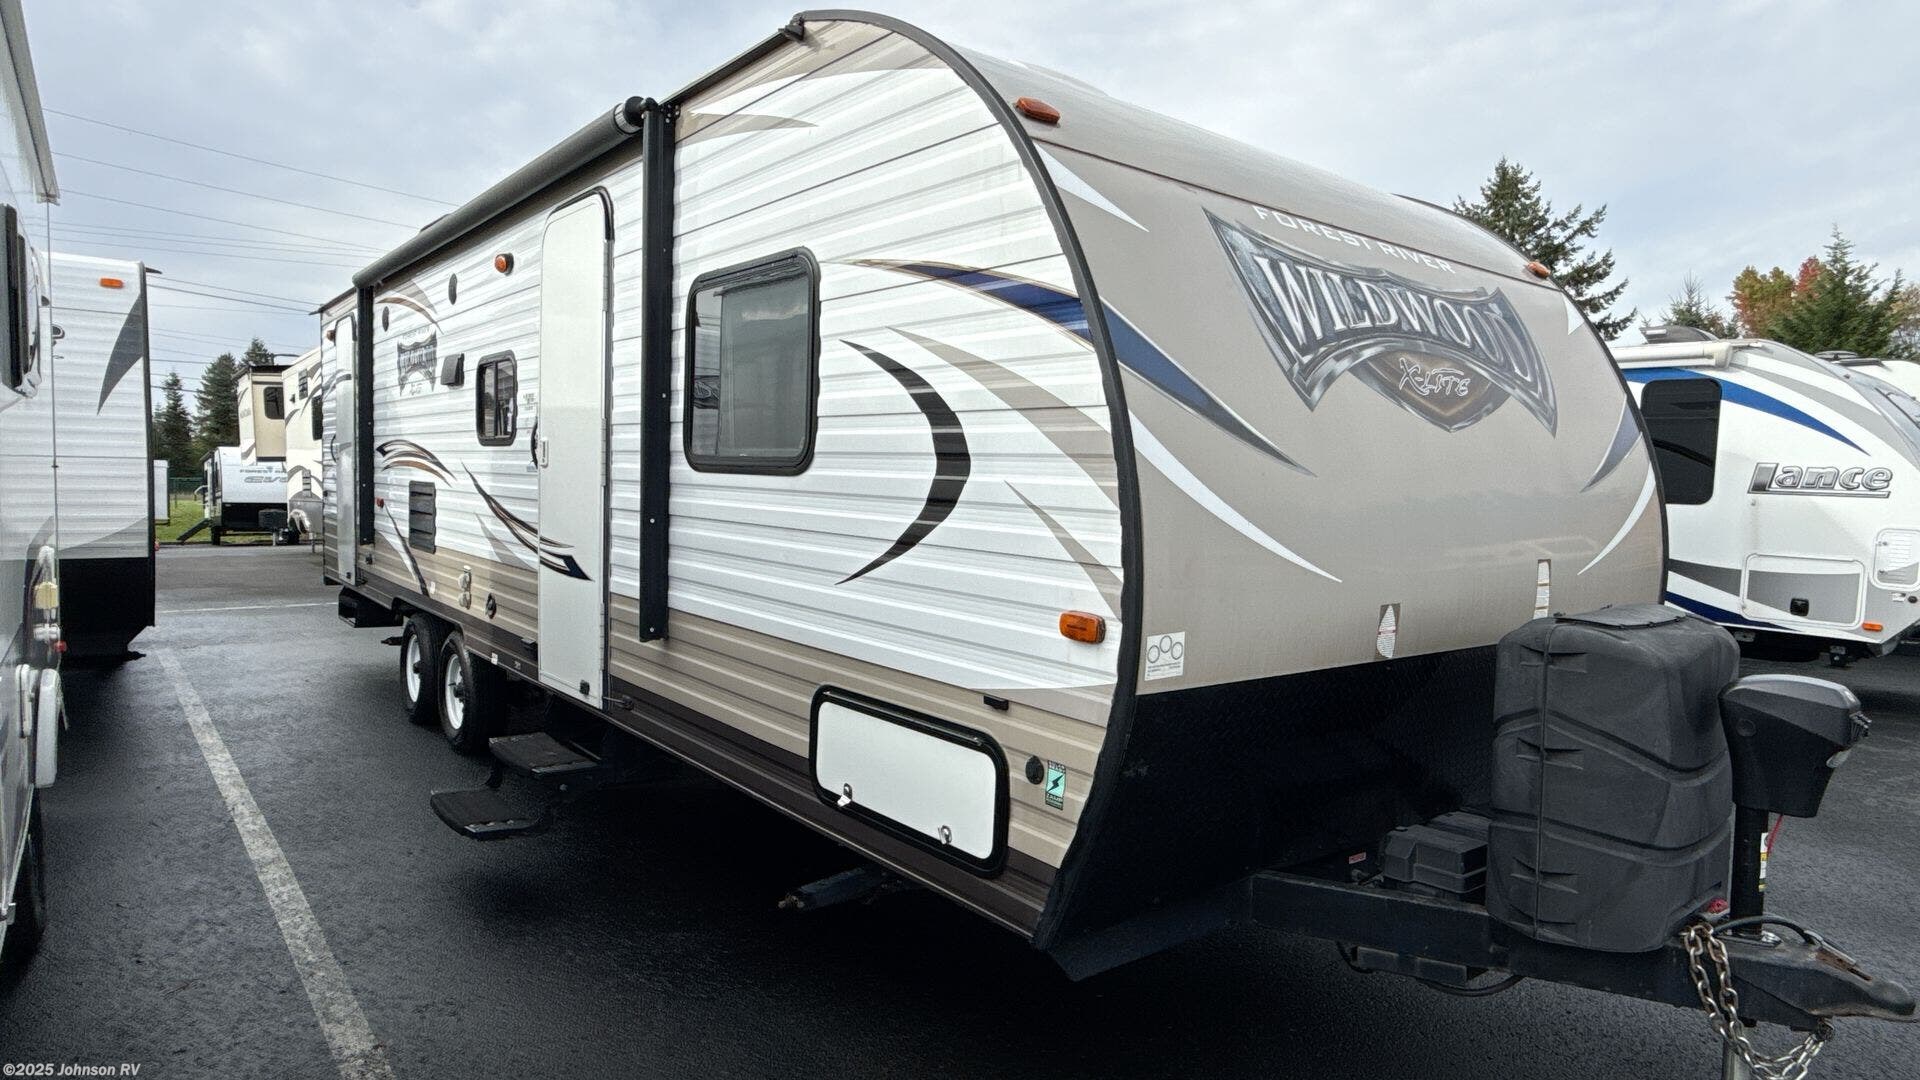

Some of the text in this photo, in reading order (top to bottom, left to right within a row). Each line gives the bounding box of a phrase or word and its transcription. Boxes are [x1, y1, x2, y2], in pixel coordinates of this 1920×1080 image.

[1253, 206, 1456, 274] FOREST RIVER
[1253, 254, 1532, 383] WILDWOOD
[1747, 462, 1894, 498] Lance
